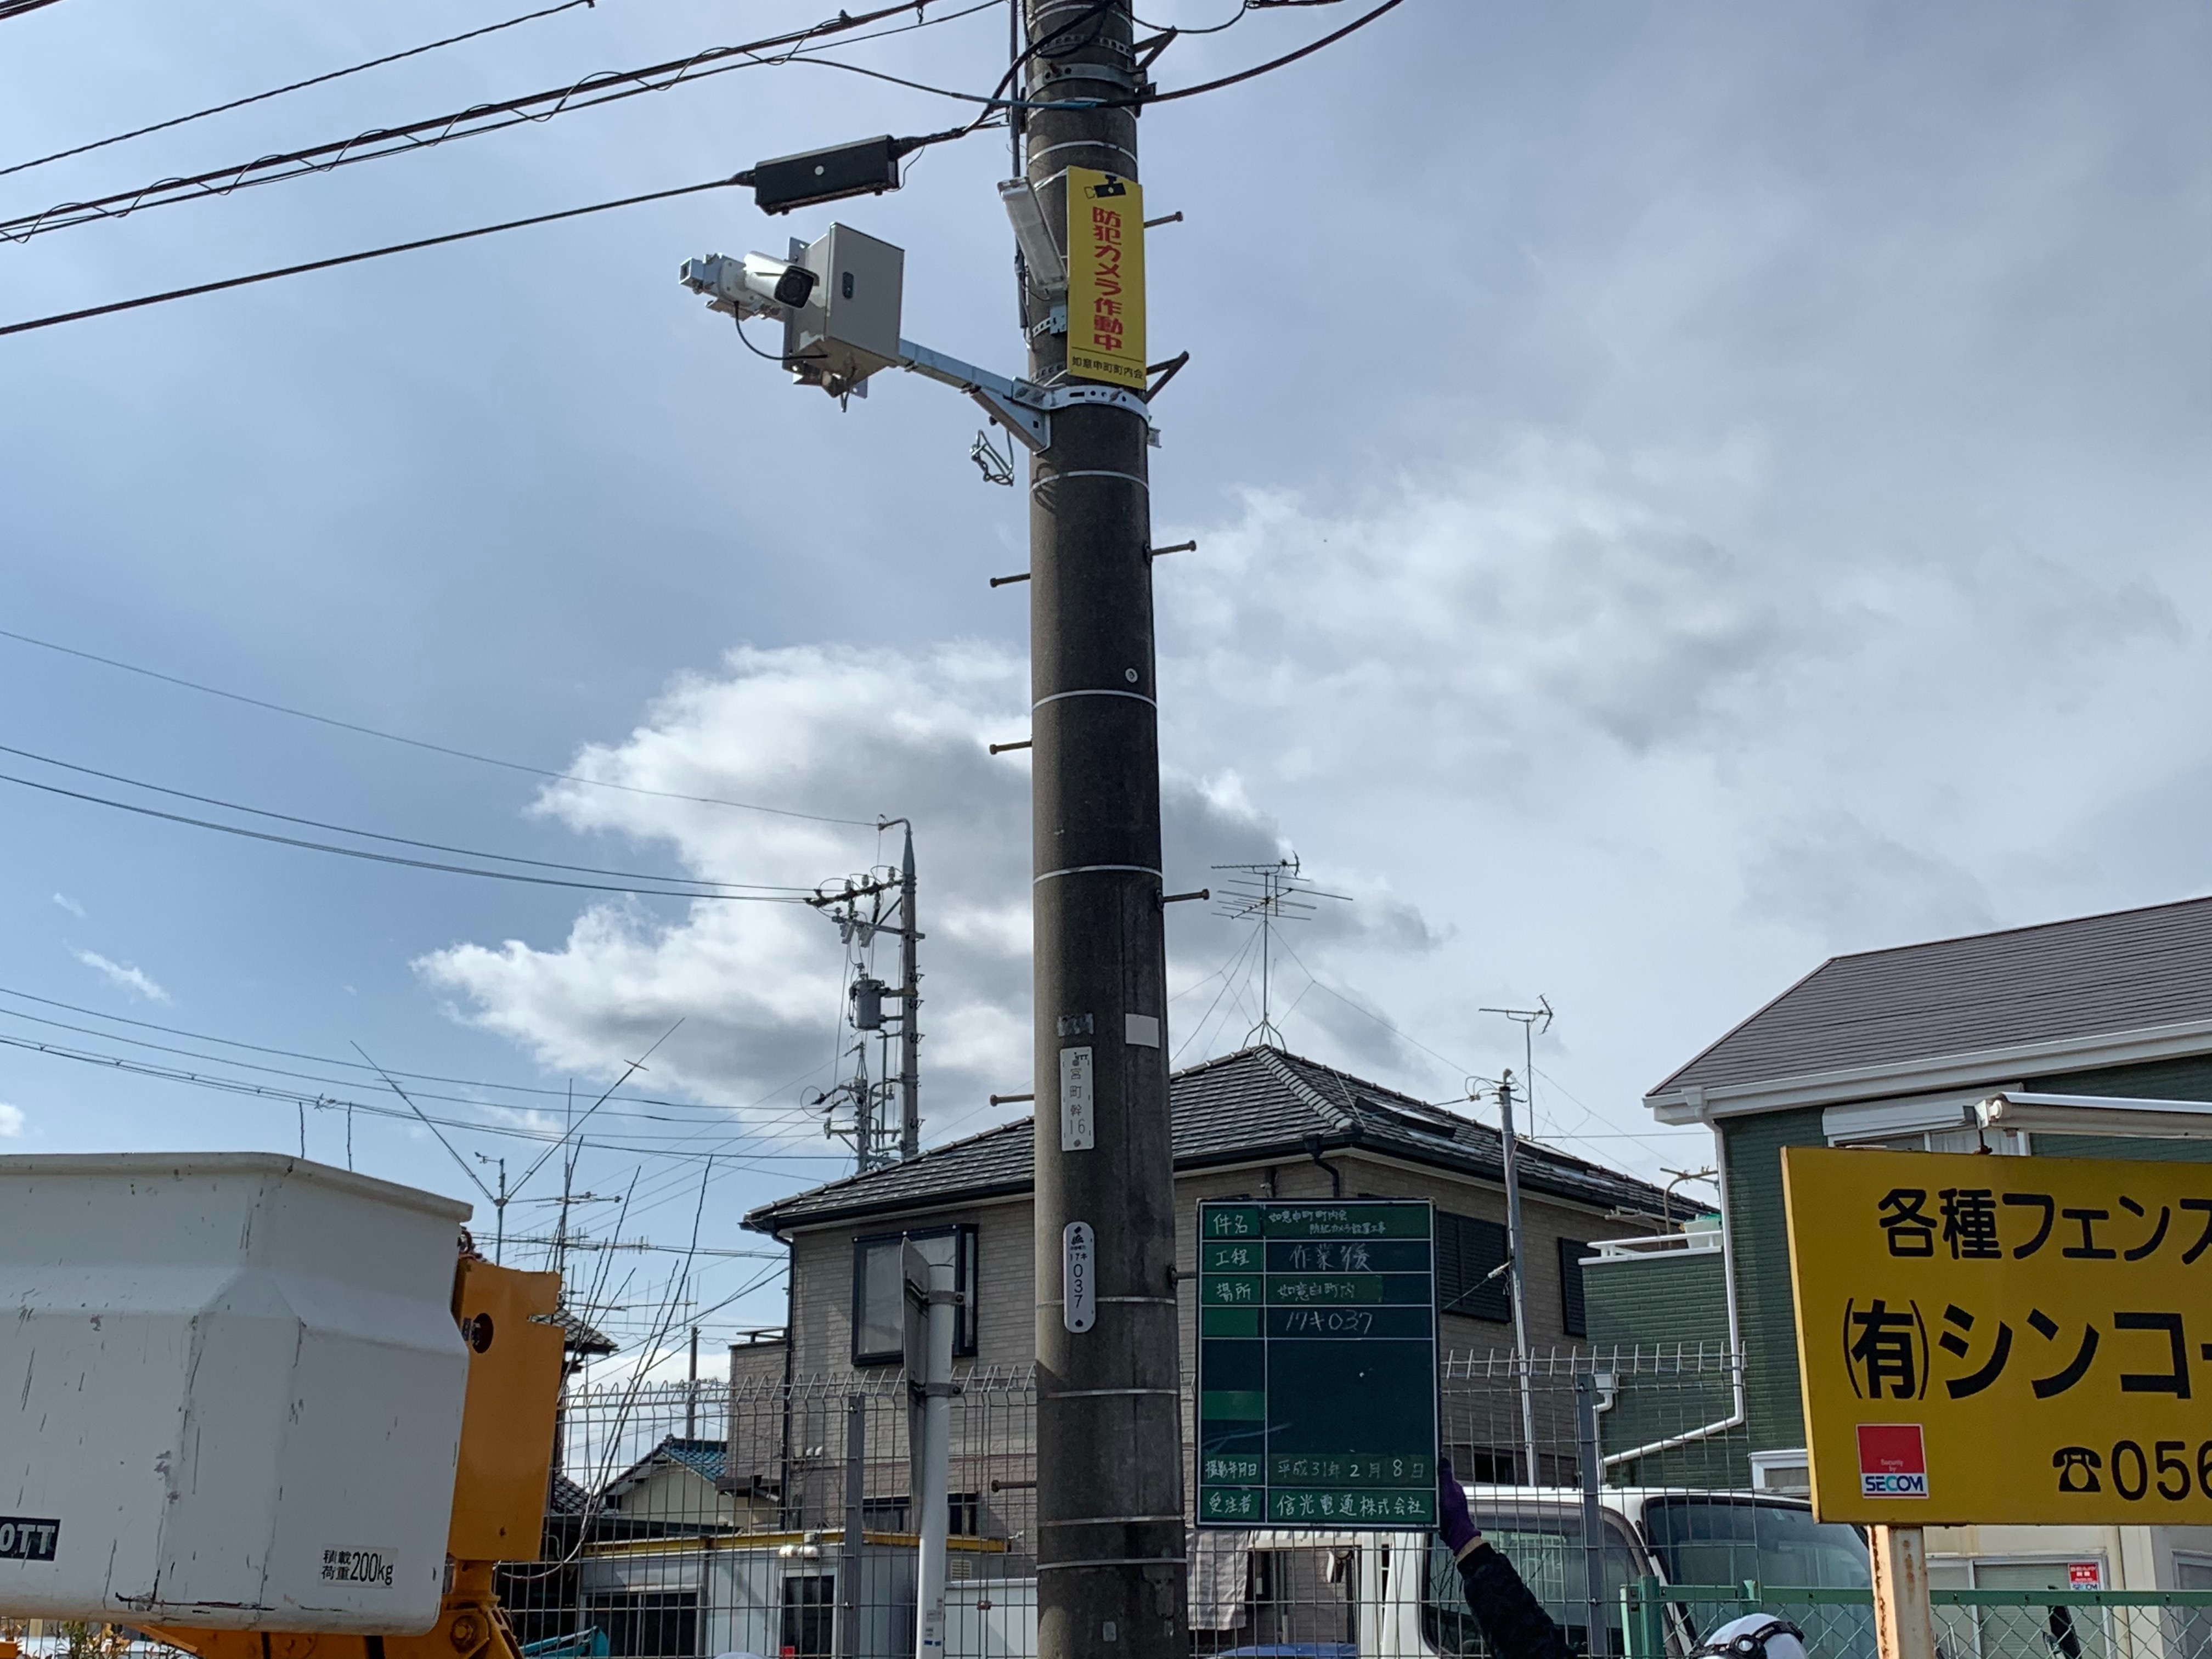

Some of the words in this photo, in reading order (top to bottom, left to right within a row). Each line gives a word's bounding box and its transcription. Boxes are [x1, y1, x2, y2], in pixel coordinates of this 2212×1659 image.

[1092, 206, 1124, 351] 防犯カメラ作動中
[1070, 1118, 1085, 1135] 16
[1214, 1213, 1248, 1235] 件名
[1215, 1248, 1250, 1266] 工程
[1289, 1243, 1373, 1272] 作業後
[1073, 1263, 1084, 1308] 037
[1216, 1282, 1251, 1303] 場所
[1843, 1297, 2212, 1401] (有)シンコ
[1205, 1460, 1257, 1479] 撮影年月日
[1865, 1475, 1923, 1492] SECOM
[1208, 1492, 1252, 1514] 受注者
[1276, 1493, 1426, 1516] 信光電通株式会社
[323, 1550, 351, 1565] 積載
[350, 1551, 394, 1585] 200kg
[321, 1565, 350, 1580] 荷重
